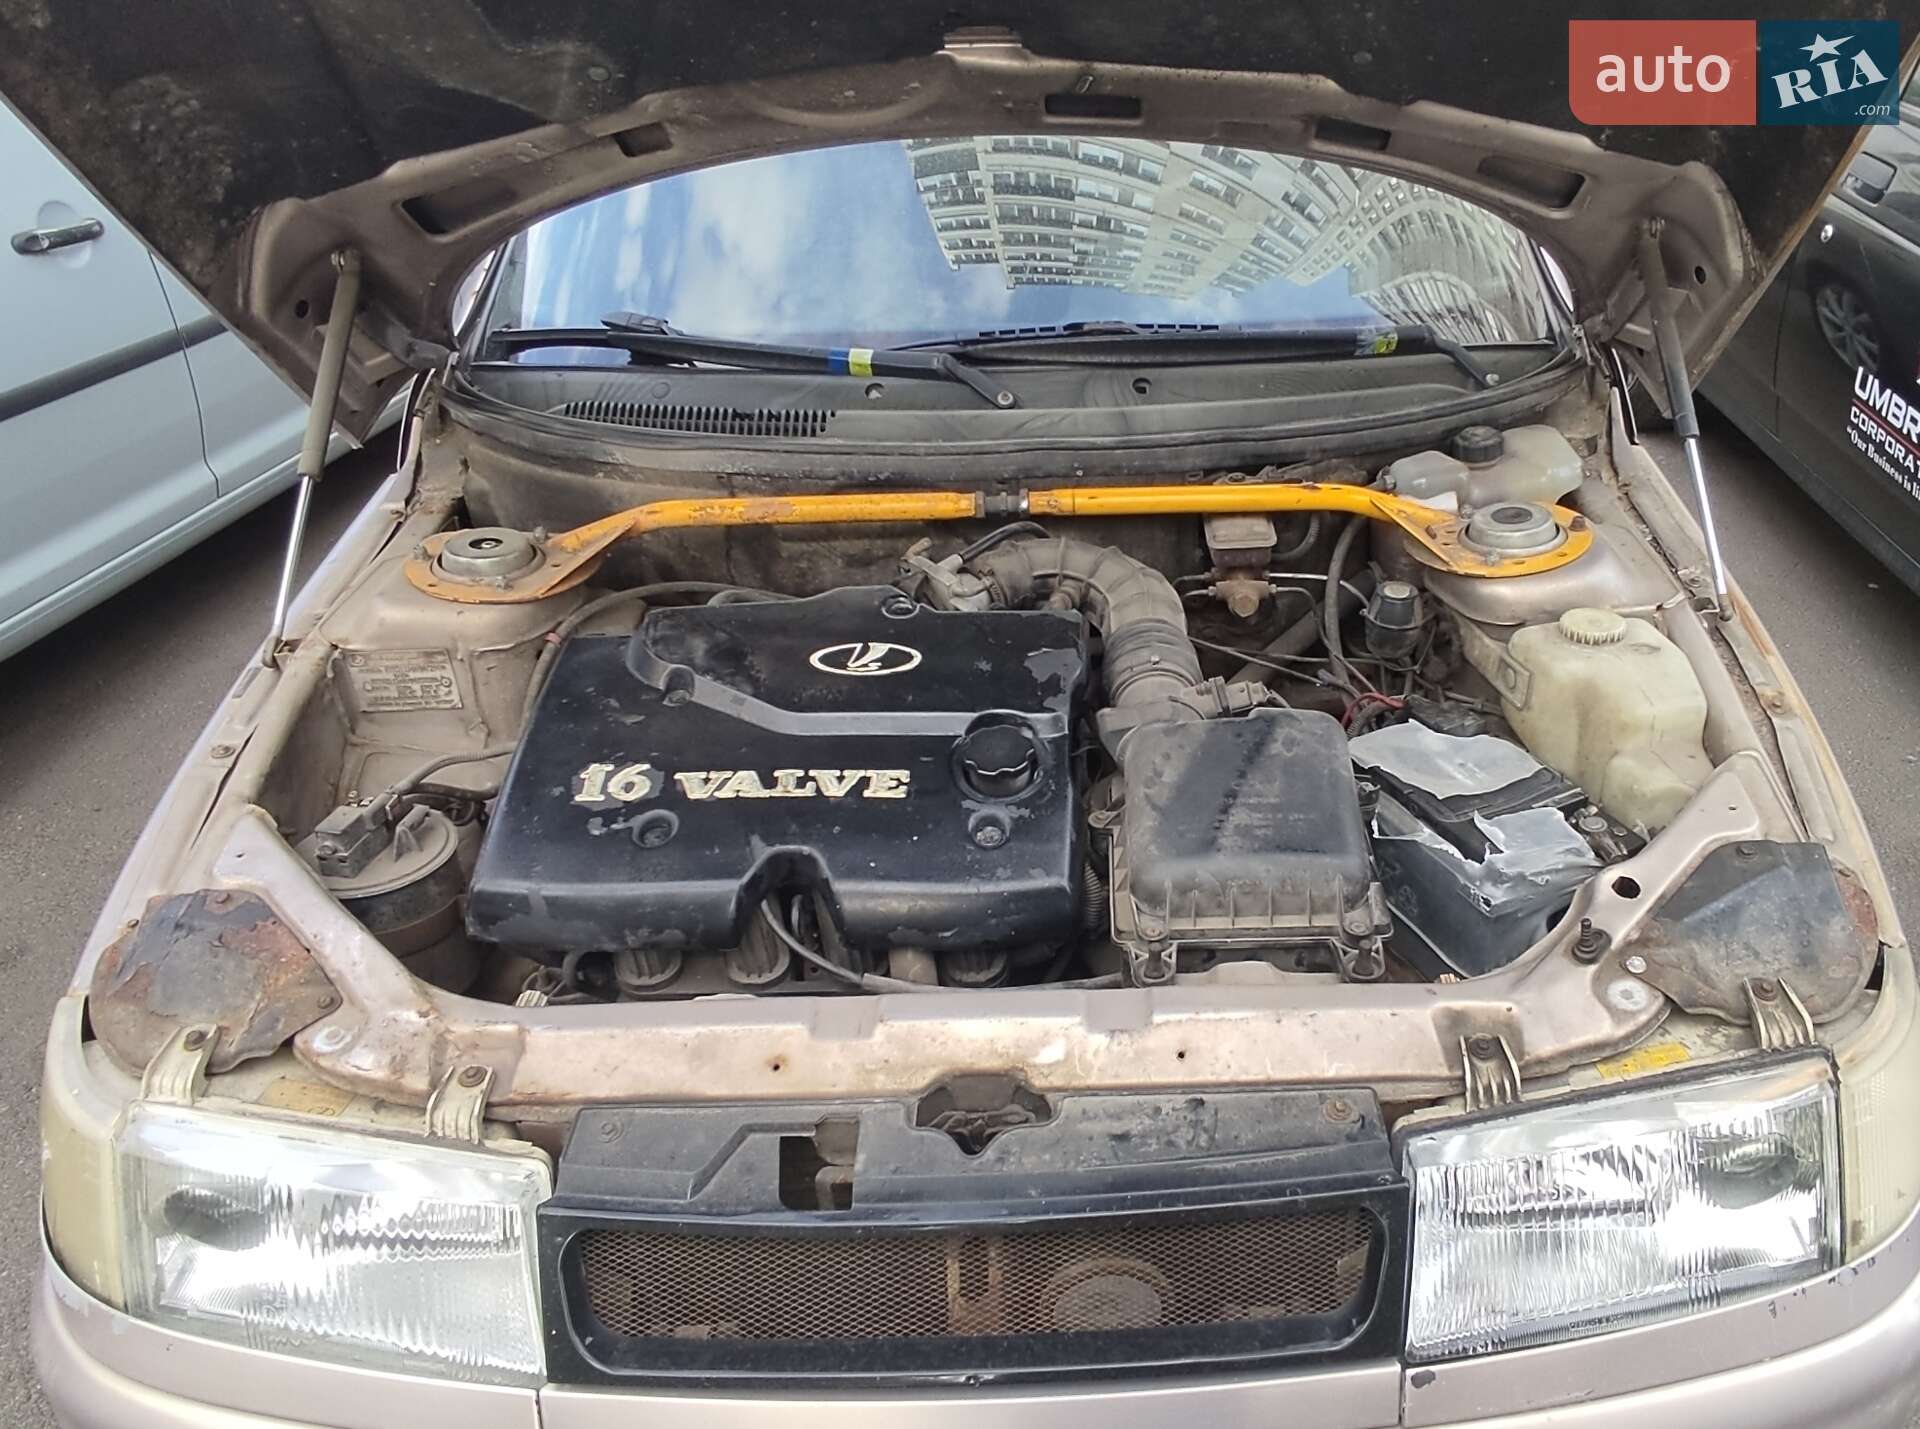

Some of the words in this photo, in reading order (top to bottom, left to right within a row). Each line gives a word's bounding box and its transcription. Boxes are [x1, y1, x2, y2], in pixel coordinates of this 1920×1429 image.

[1867, 442, 1903, 484] Business
[574, 763, 651, 802] 16
[673, 768, 911, 800] VALVE
